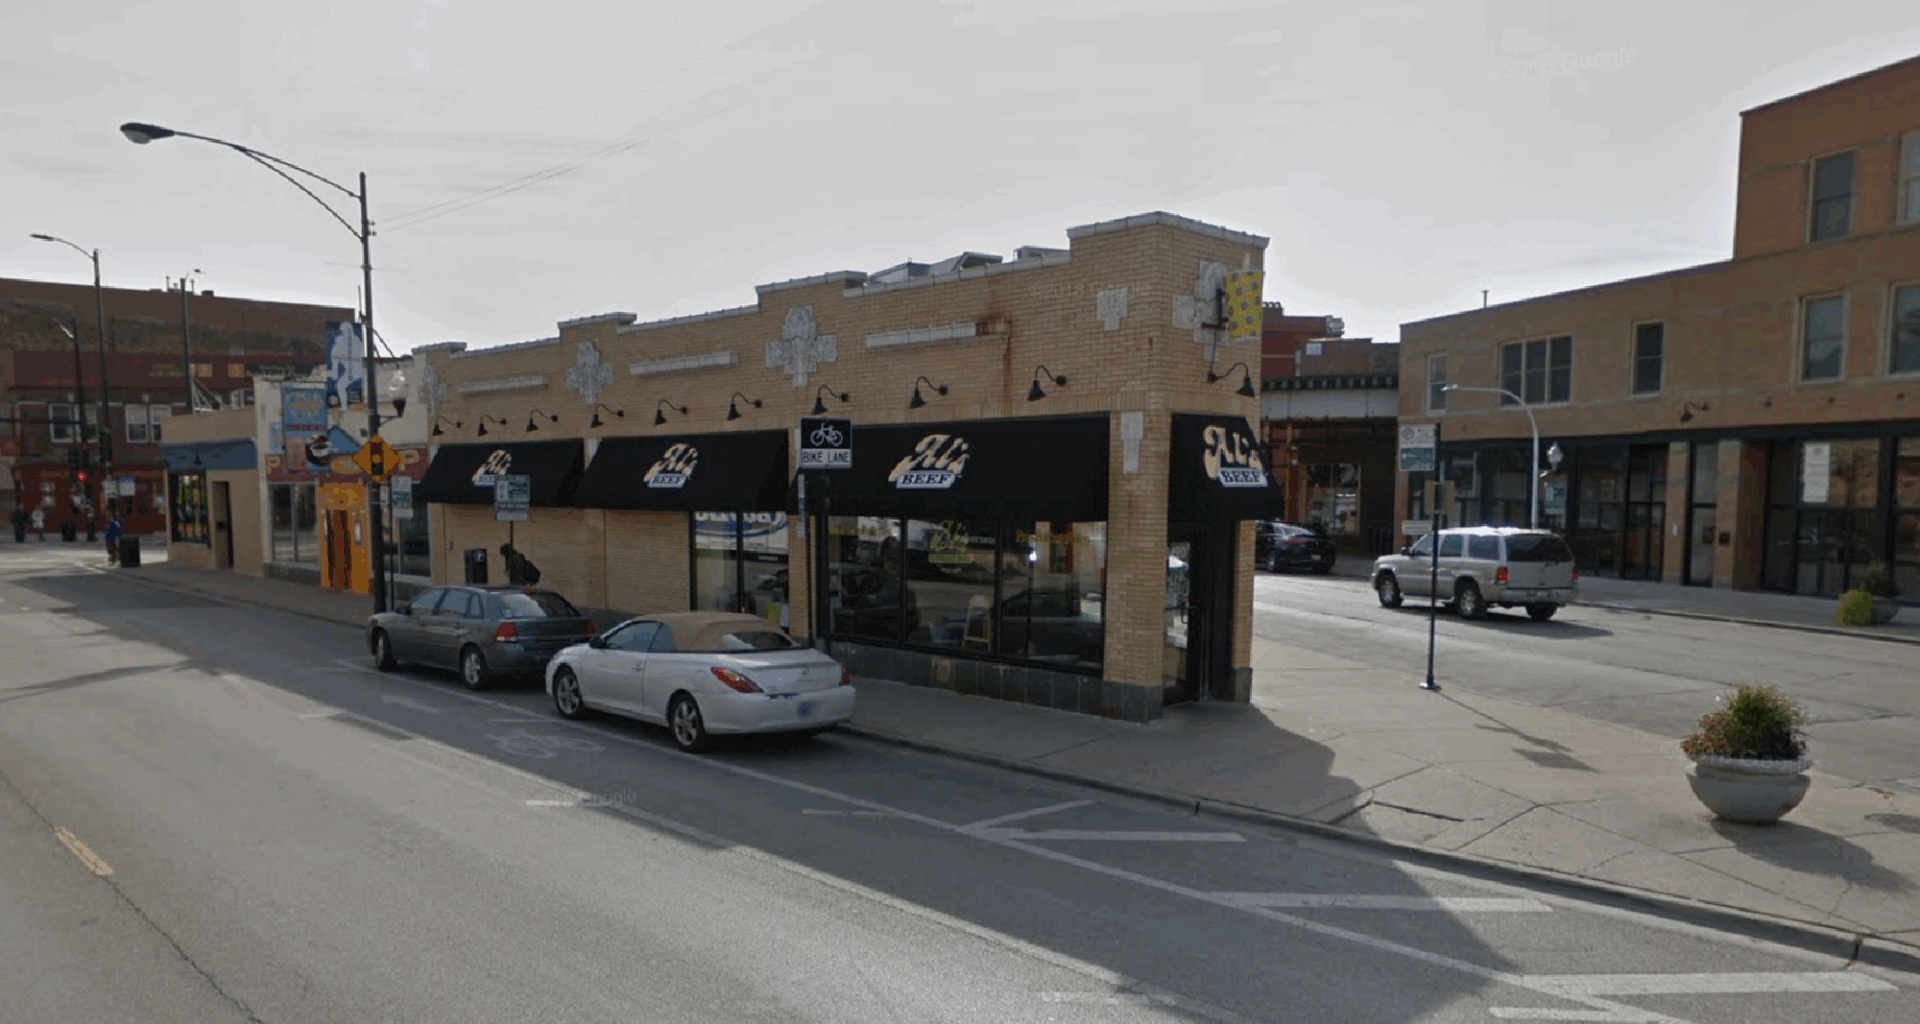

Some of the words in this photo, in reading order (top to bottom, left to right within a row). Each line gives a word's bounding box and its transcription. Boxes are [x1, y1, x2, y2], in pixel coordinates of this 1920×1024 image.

[802, 452, 823, 463] BIKE
[827, 452, 850, 463] LANE
[888, 434, 970, 482] Al's
[1203, 426, 1264, 480] Al's
[643, 443, 699, 482] Al's
[652, 475, 682, 485] BEEF
[901, 474, 952, 485] BEEF
[1220, 470, 1262, 483] BEEF
